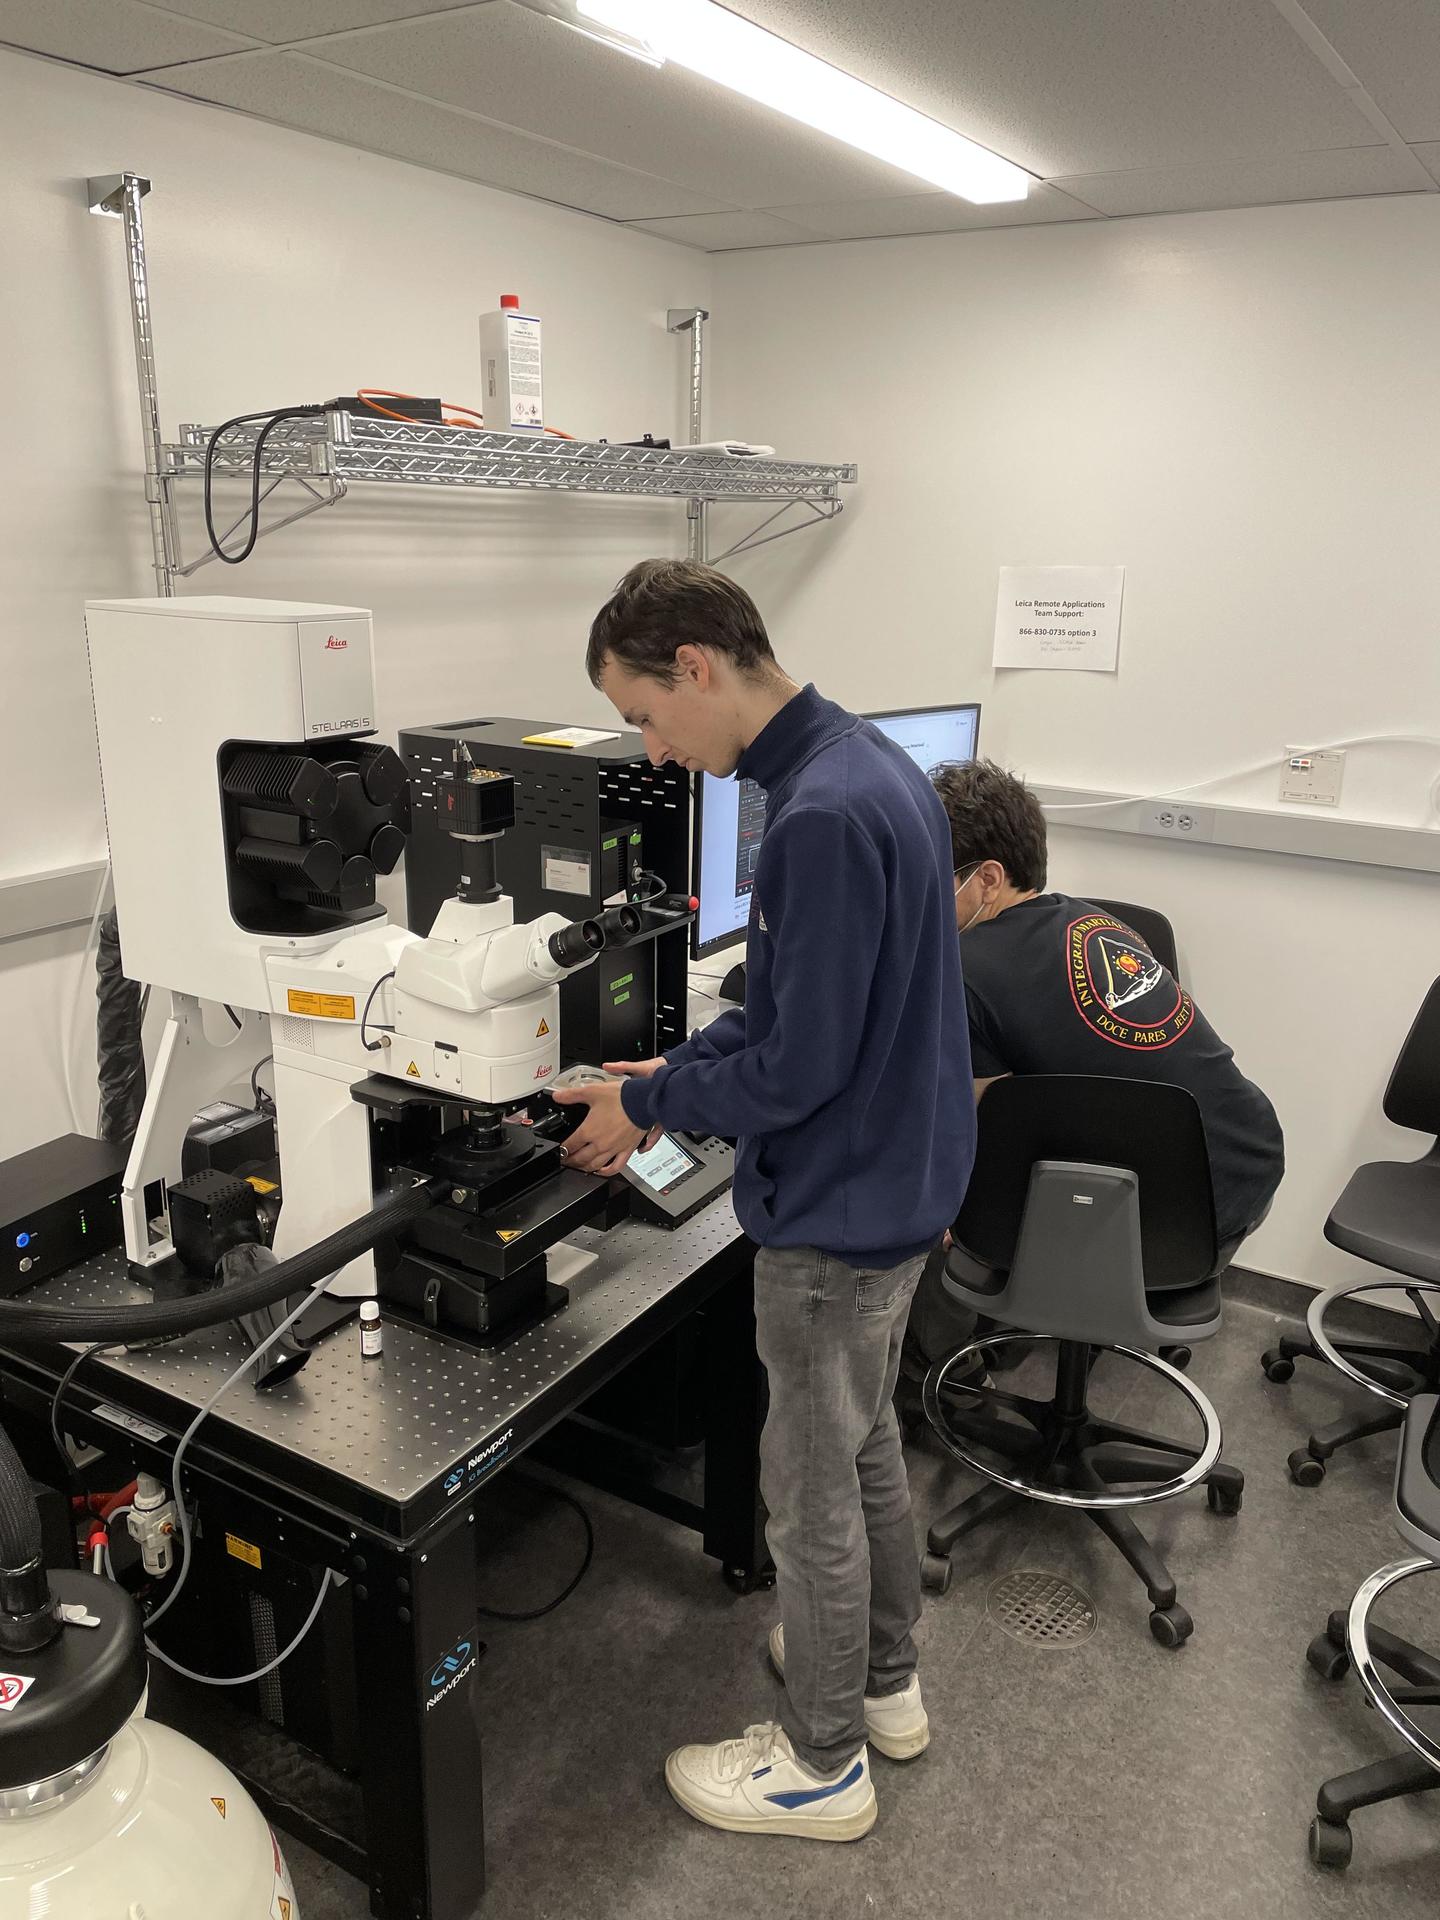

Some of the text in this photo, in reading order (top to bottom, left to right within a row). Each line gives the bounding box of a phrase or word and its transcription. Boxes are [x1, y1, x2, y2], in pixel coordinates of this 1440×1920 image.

[1034, 600, 1060, 608] Remote
[1062, 600, 1105, 609] Applications
[1034, 609, 1084, 618] Team Support:
[325, 635, 349, 650] Leica
[1019, 628, 1066, 636] 866-830-0735
[1067, 629, 1091, 637] option
[1072, 929, 1094, 1008] INTEGRATD
[1096, 1006, 1190, 1043] DOCE PARES JEET
[467, 1428, 514, 1471] Newport
[426, 1657, 477, 1711] Newport
